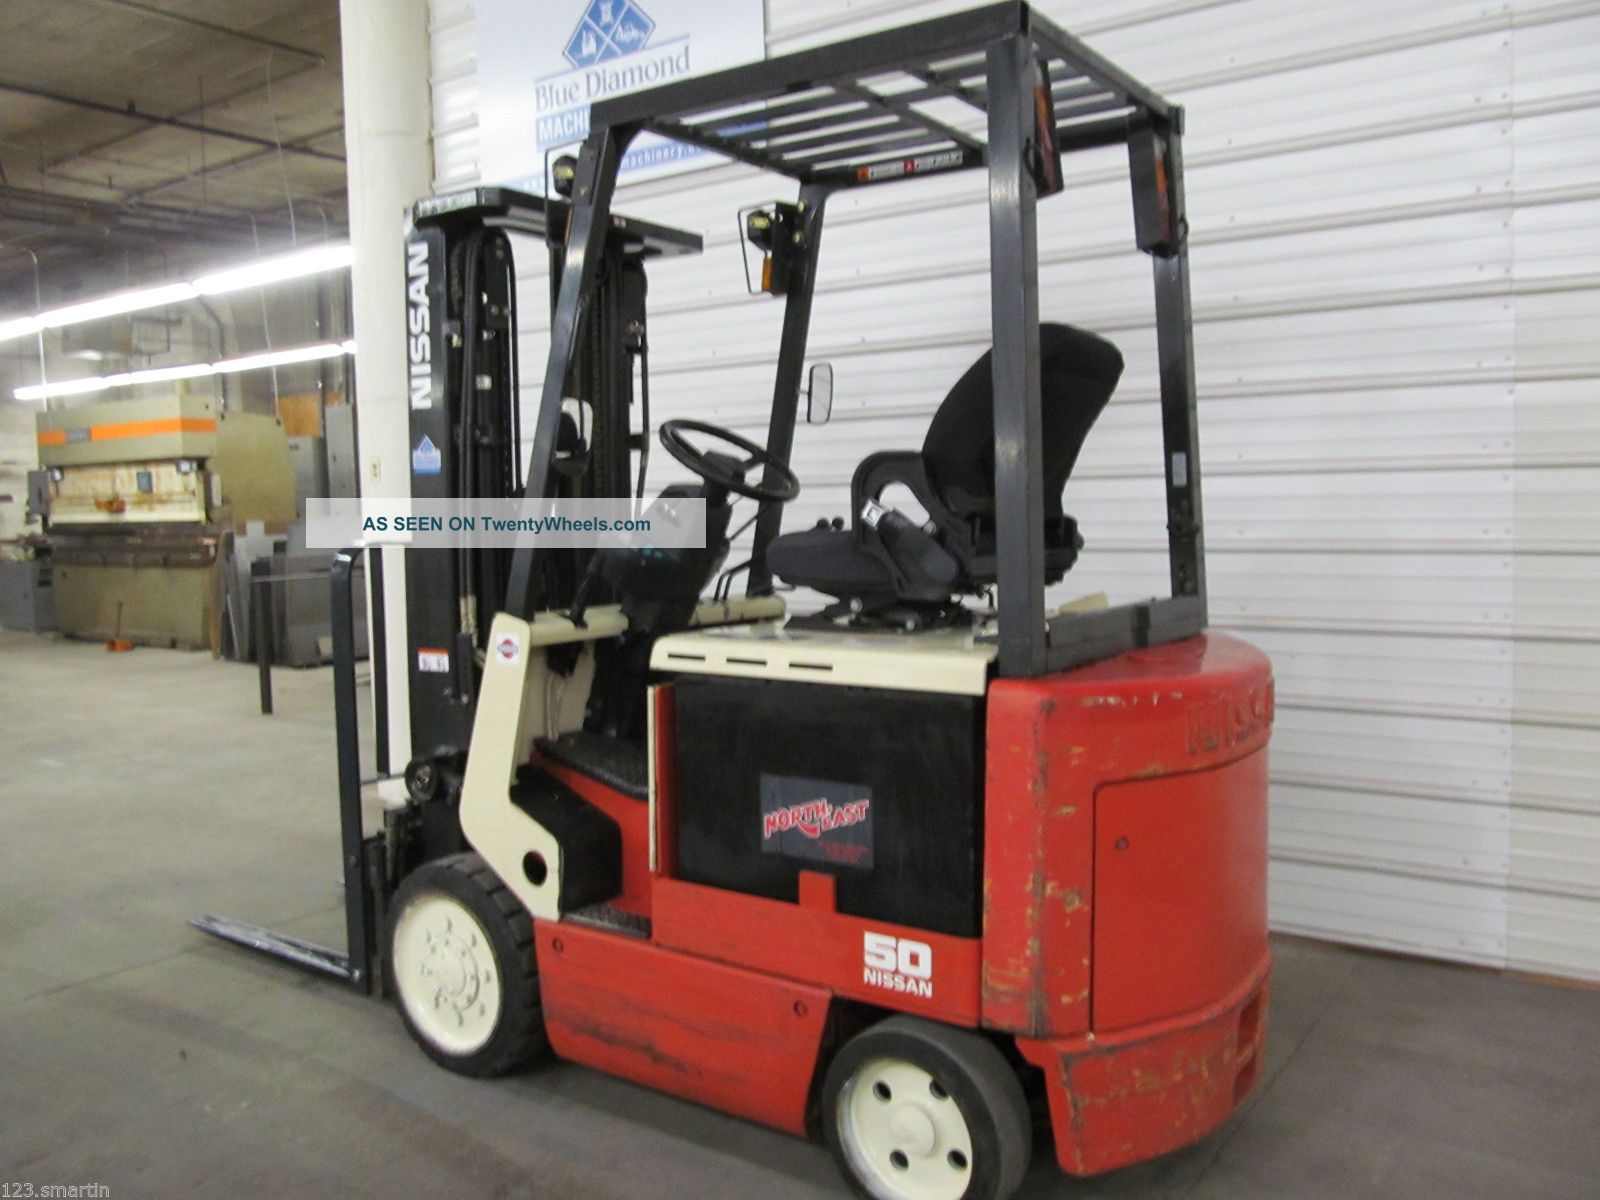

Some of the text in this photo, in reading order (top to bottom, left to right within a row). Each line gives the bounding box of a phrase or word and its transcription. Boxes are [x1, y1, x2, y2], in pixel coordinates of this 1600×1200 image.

[535, 44, 691, 113] Blue Diamond
[538, 107, 591, 143] MACHI
[407, 241, 433, 410] NISSAN
[763, 797, 828, 839] NORTH
[863, 930, 932, 980] 50
[863, 967, 933, 998] NISSAN
